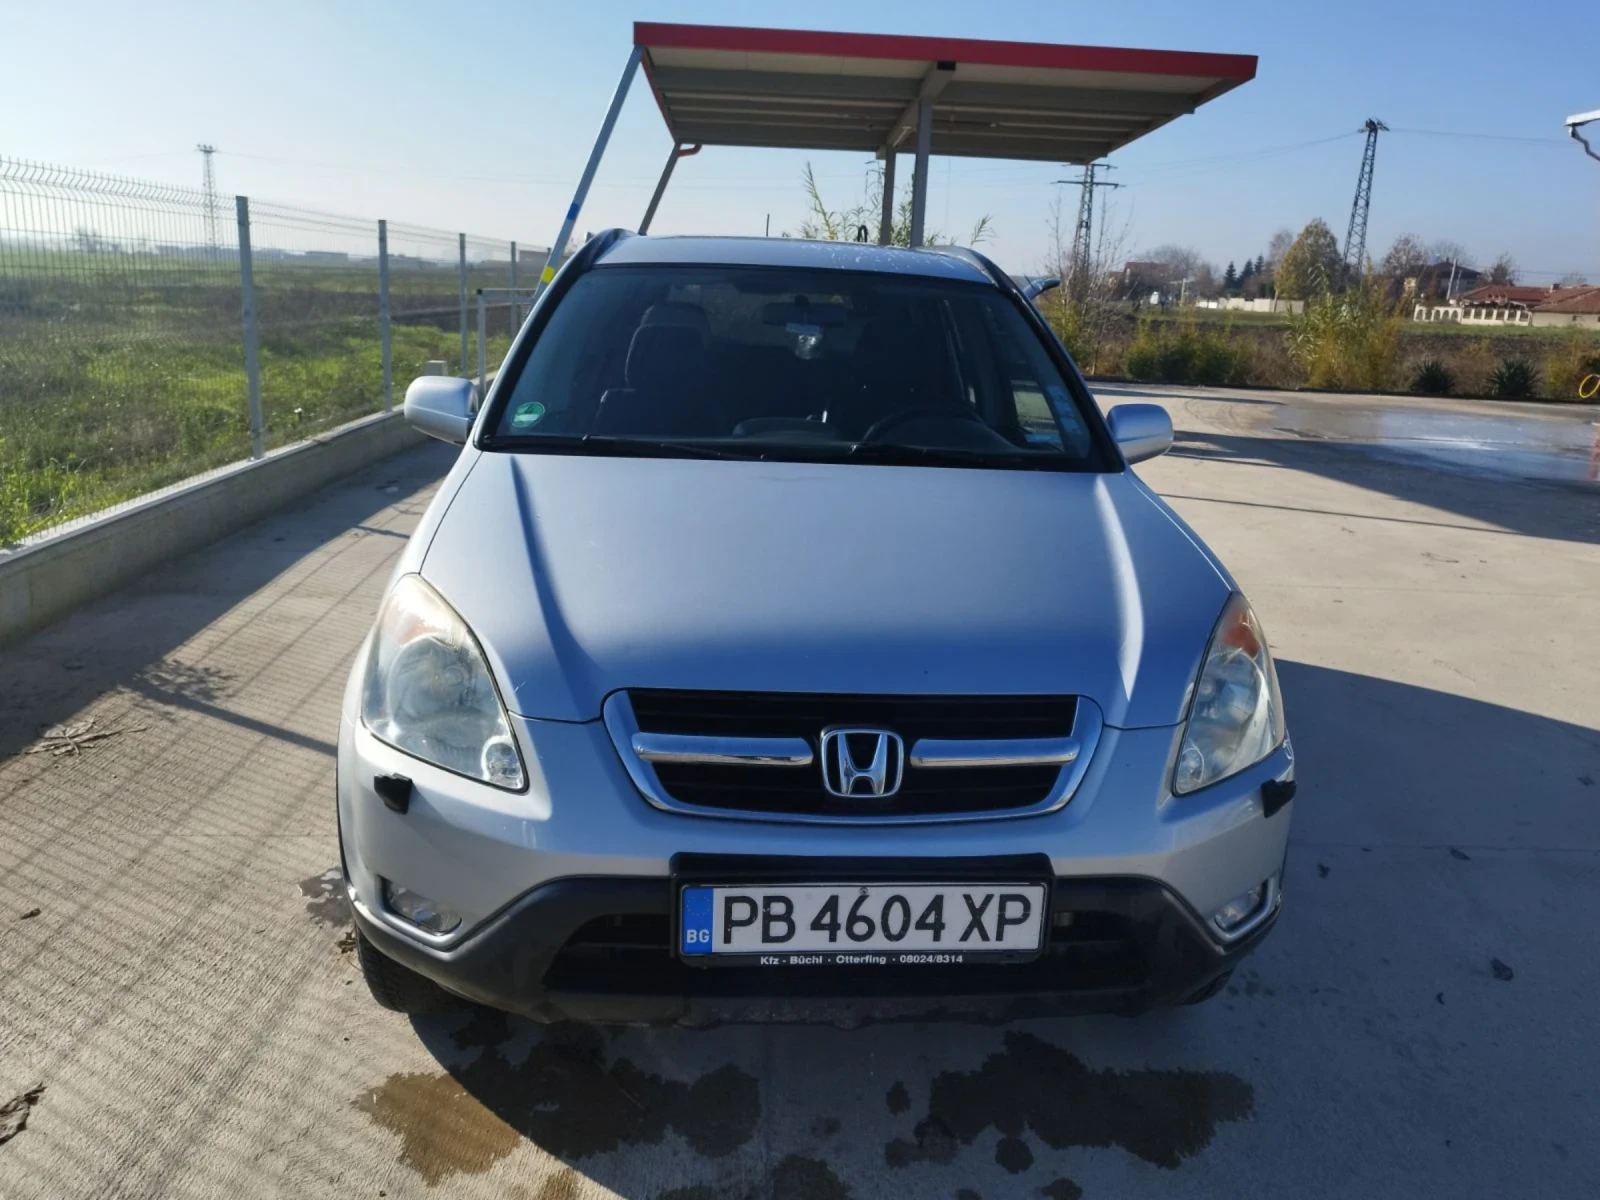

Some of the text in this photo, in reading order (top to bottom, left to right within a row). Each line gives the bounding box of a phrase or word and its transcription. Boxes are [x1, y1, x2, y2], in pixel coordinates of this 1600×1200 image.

[723, 893, 1031, 945] PB 4604 XP
[686, 929, 710, 944] BG
[760, 954, 963, 965] Kfz Büchl Otterfing 08024/8314
